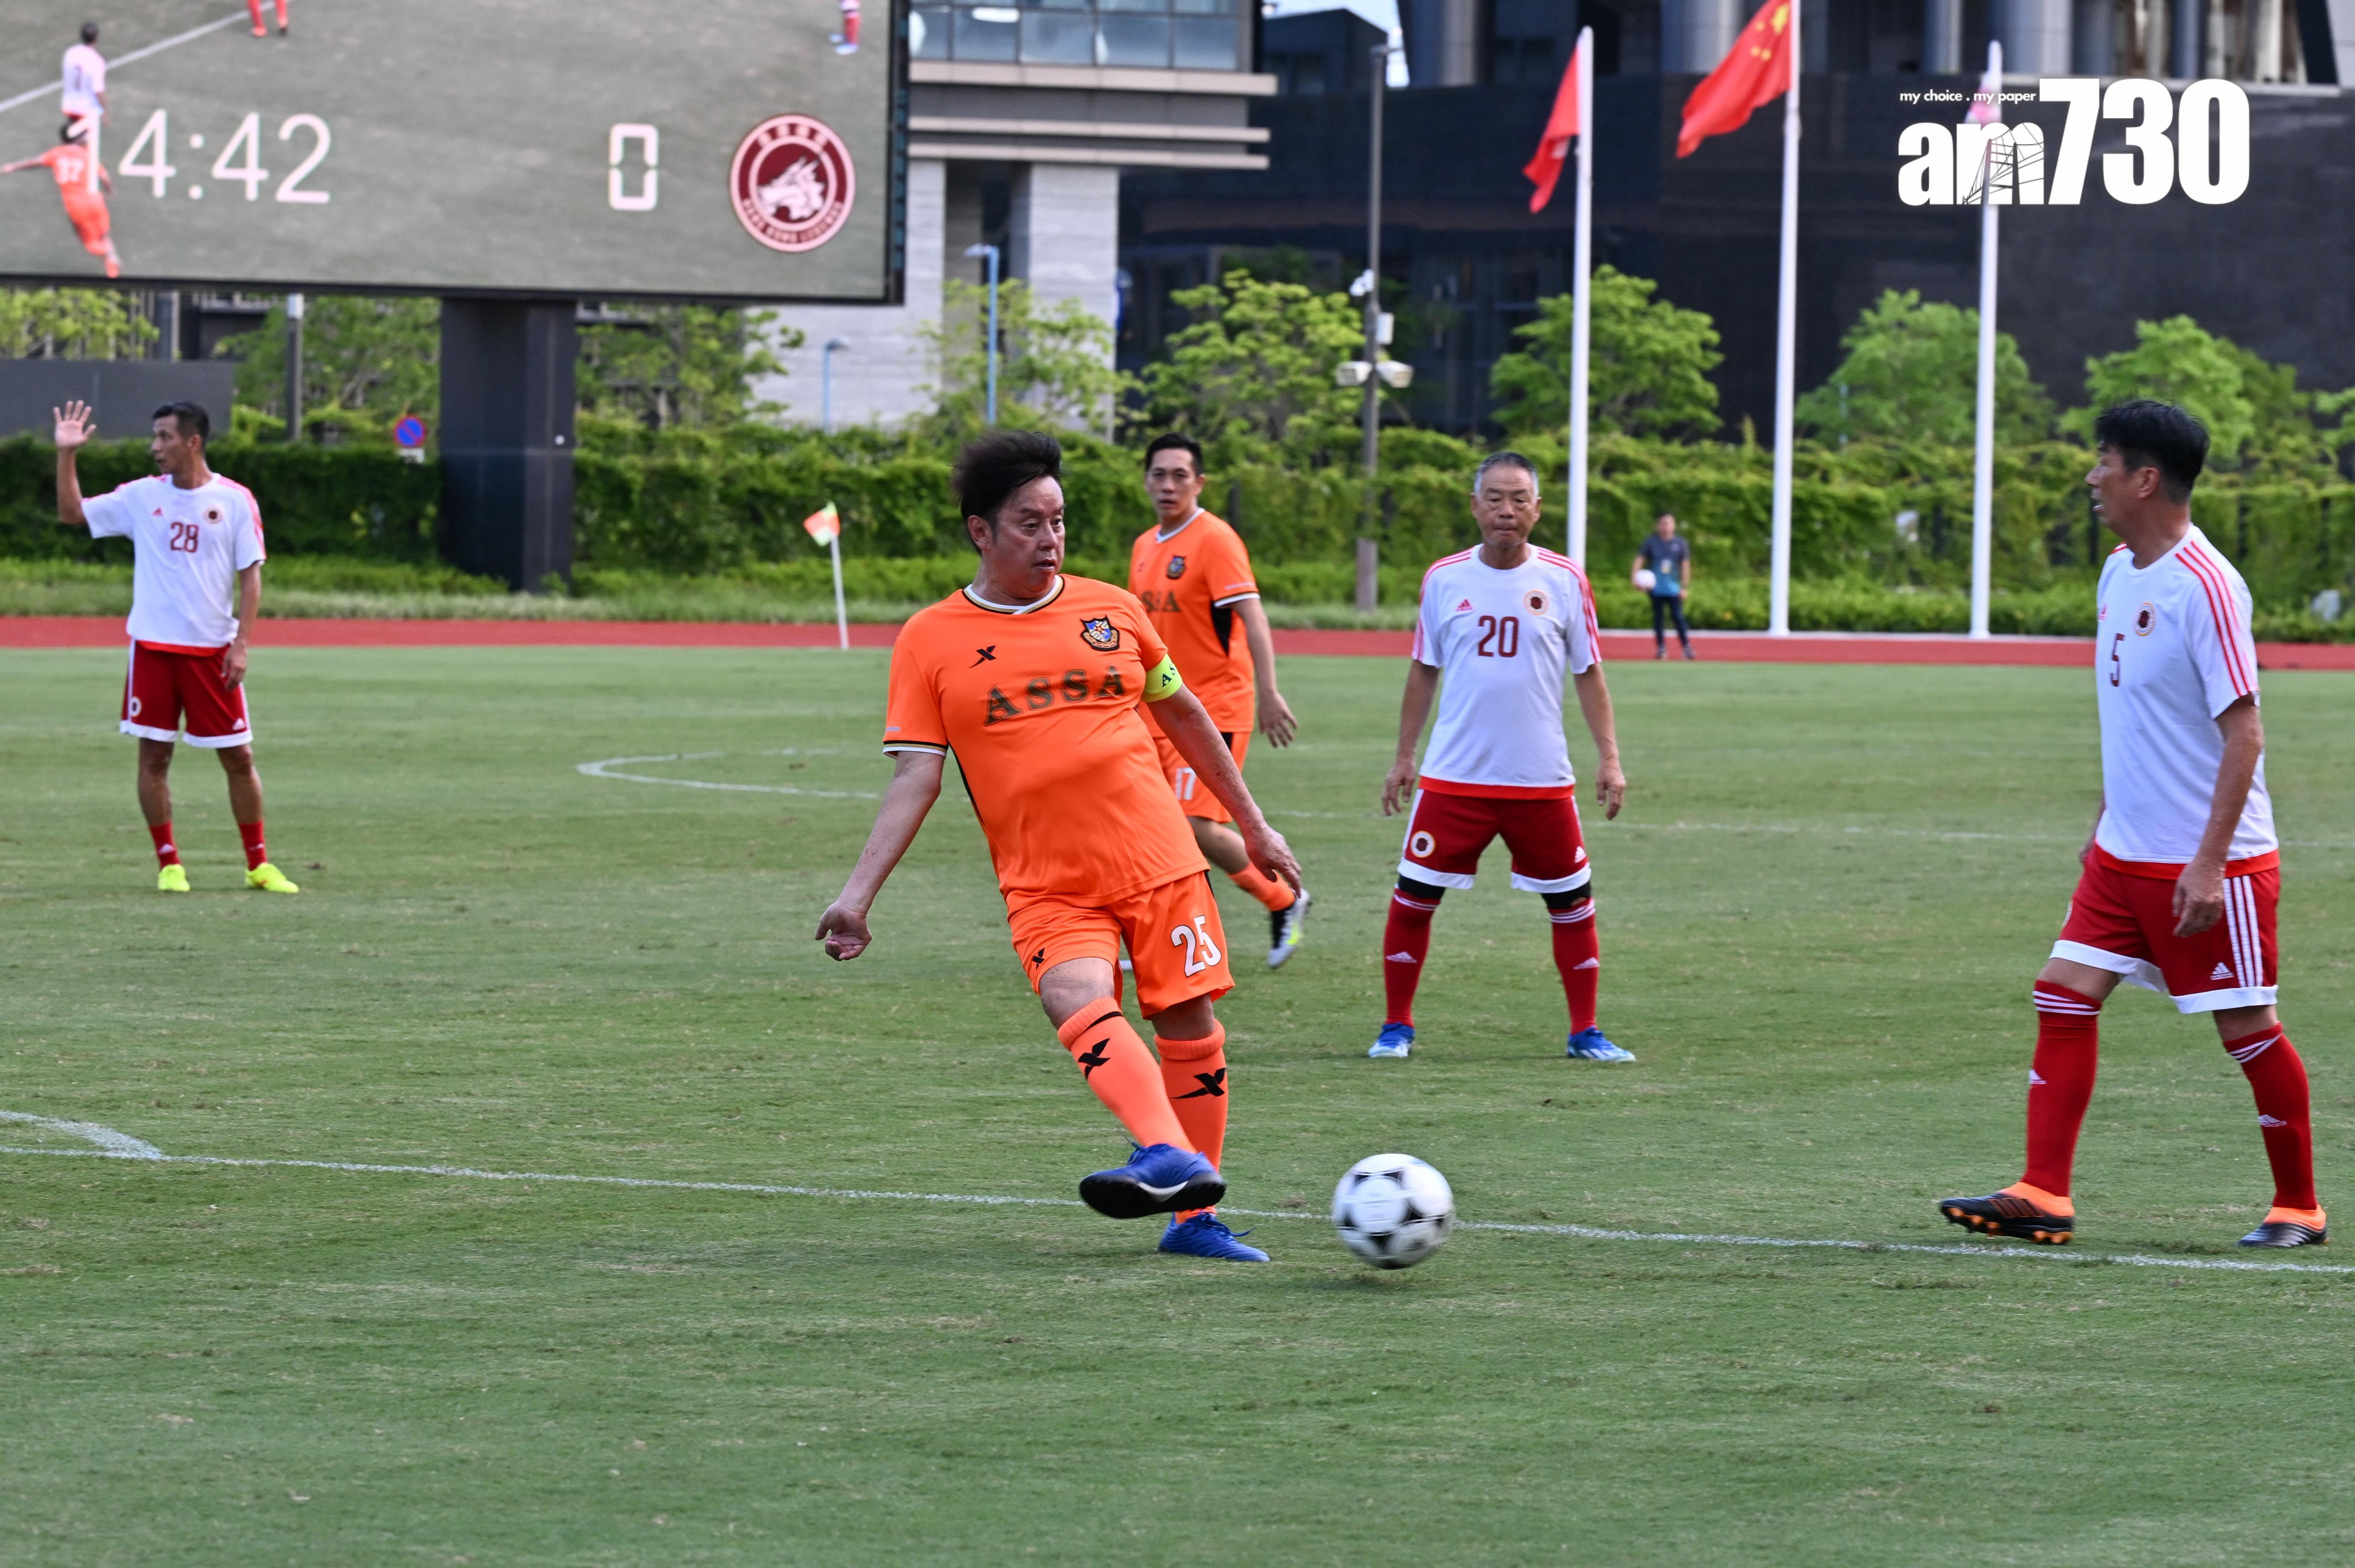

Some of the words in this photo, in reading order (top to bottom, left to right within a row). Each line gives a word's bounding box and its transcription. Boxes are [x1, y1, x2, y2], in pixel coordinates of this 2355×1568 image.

[609, 123, 658, 211] 0
[170, 522, 199, 553] 28
[1478, 615, 1519, 657] 20
[2110, 633, 2125, 687] 5
[983, 664, 1126, 727] ASSA
[1175, 767, 1197, 801] 17
[1171, 915, 1222, 978] 25
